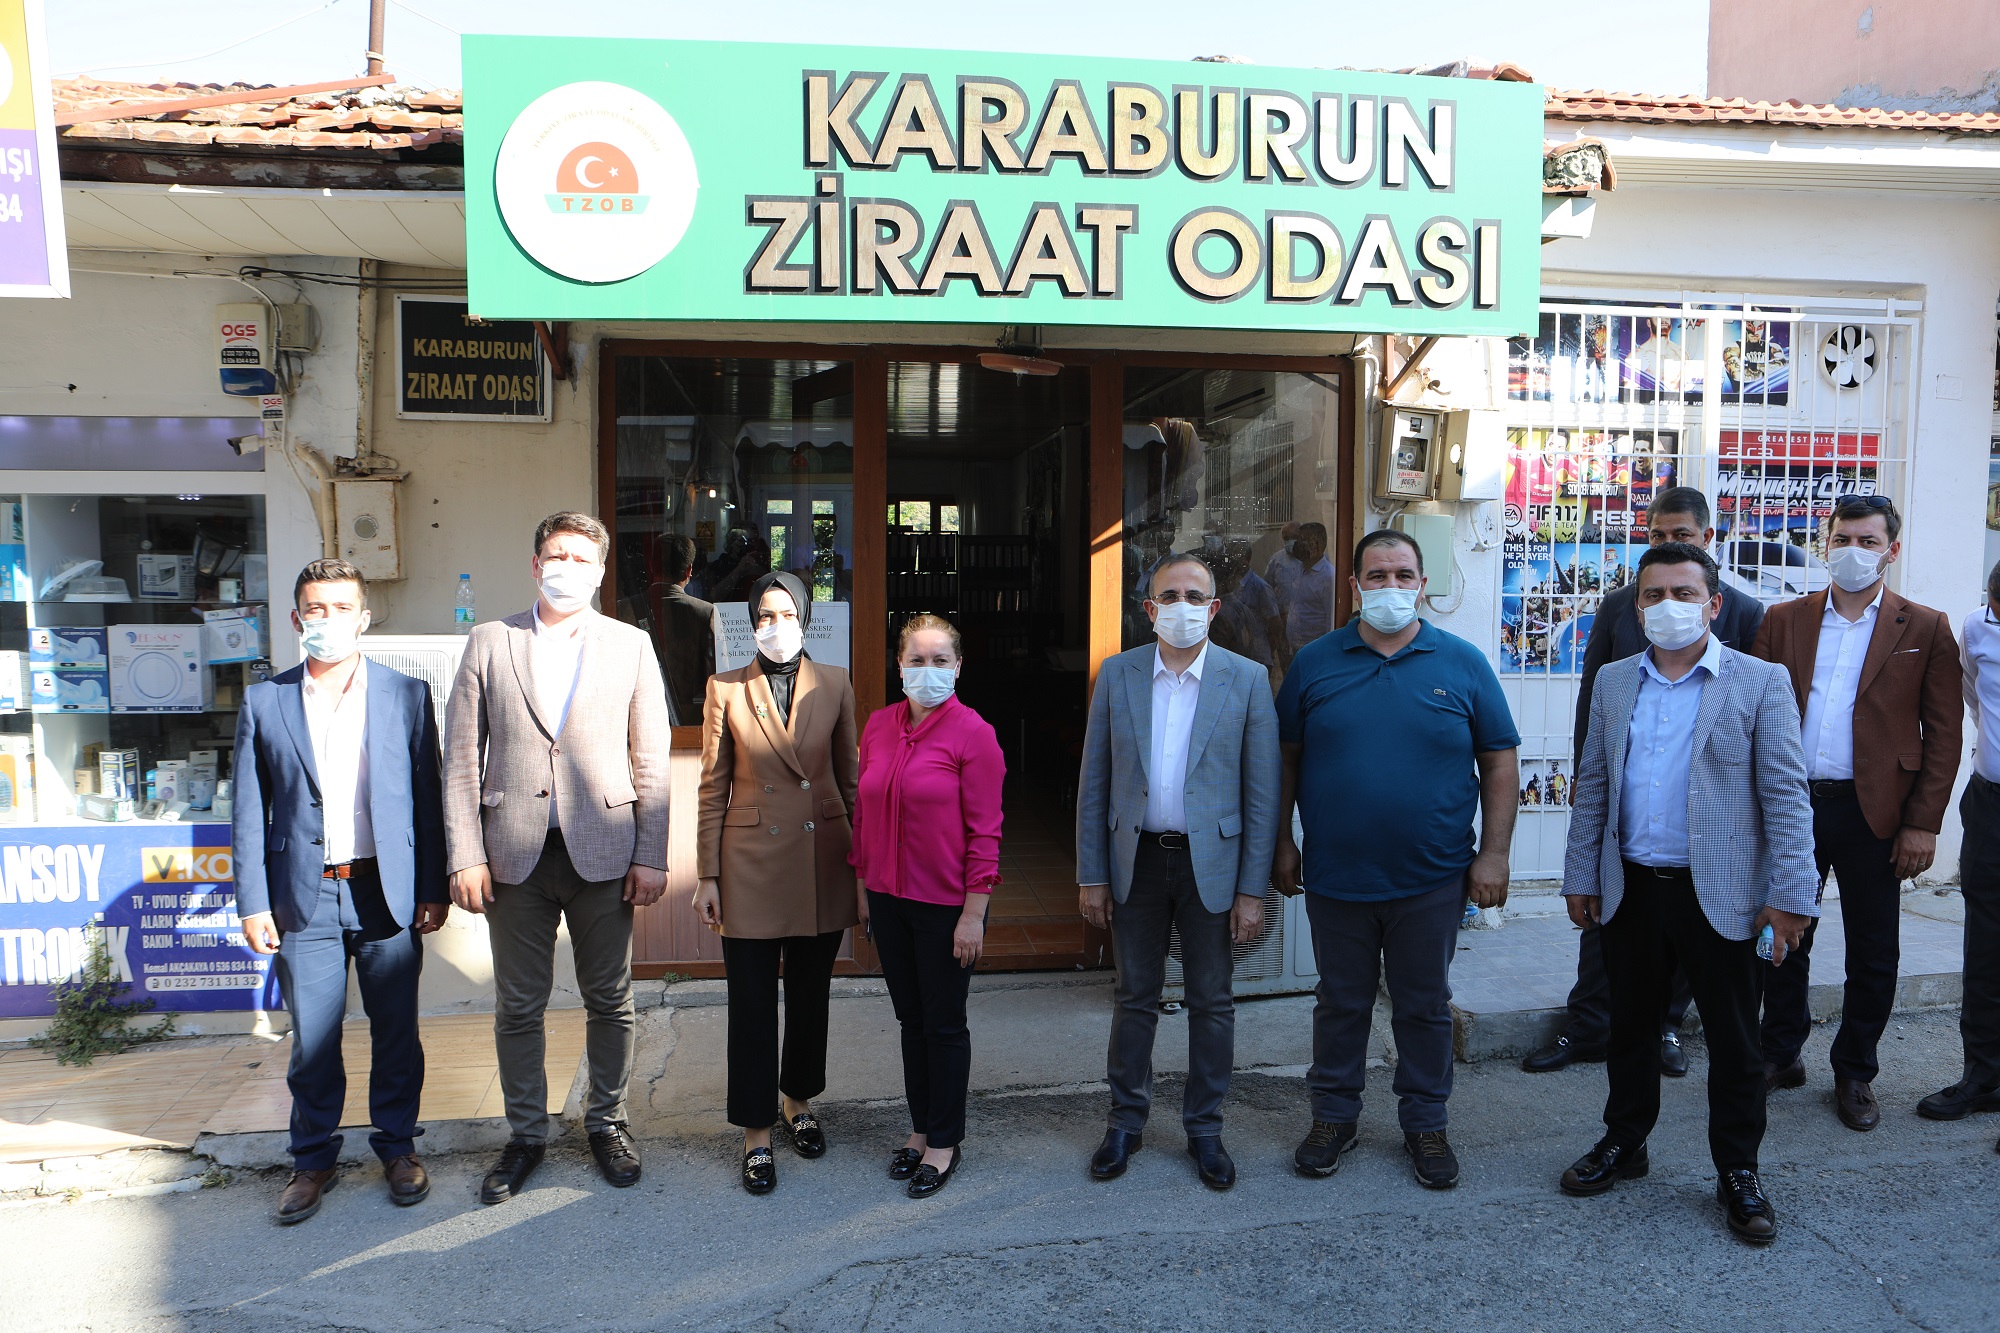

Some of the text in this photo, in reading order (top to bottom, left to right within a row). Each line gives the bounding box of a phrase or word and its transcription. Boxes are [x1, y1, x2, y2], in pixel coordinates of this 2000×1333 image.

[803, 69, 1457, 193] KARABURUN
[562, 198, 634, 212] TZOB
[743, 172, 1502, 311] ZİRAAT ODASI
[221, 324, 257, 337] OGS
[413, 338, 533, 361] KARABURUN
[407, 373, 477, 400] ZİRAAT
[1757, 435, 1808, 443] GREAEST
[1631, 493, 1653, 502] QATA
[1505, 544, 1523, 552] THIS
[1507, 561, 1523, 569] OLD
[152, 894, 177, 909] UYDU
[141, 914, 173, 929] ALARM
[142, 934, 173, 948] BAKIM
[182, 934, 217, 948] MONTAJ
[144, 963, 168, 973] Kemal
[164, 976, 257, 987] 0 232 731 31 32
